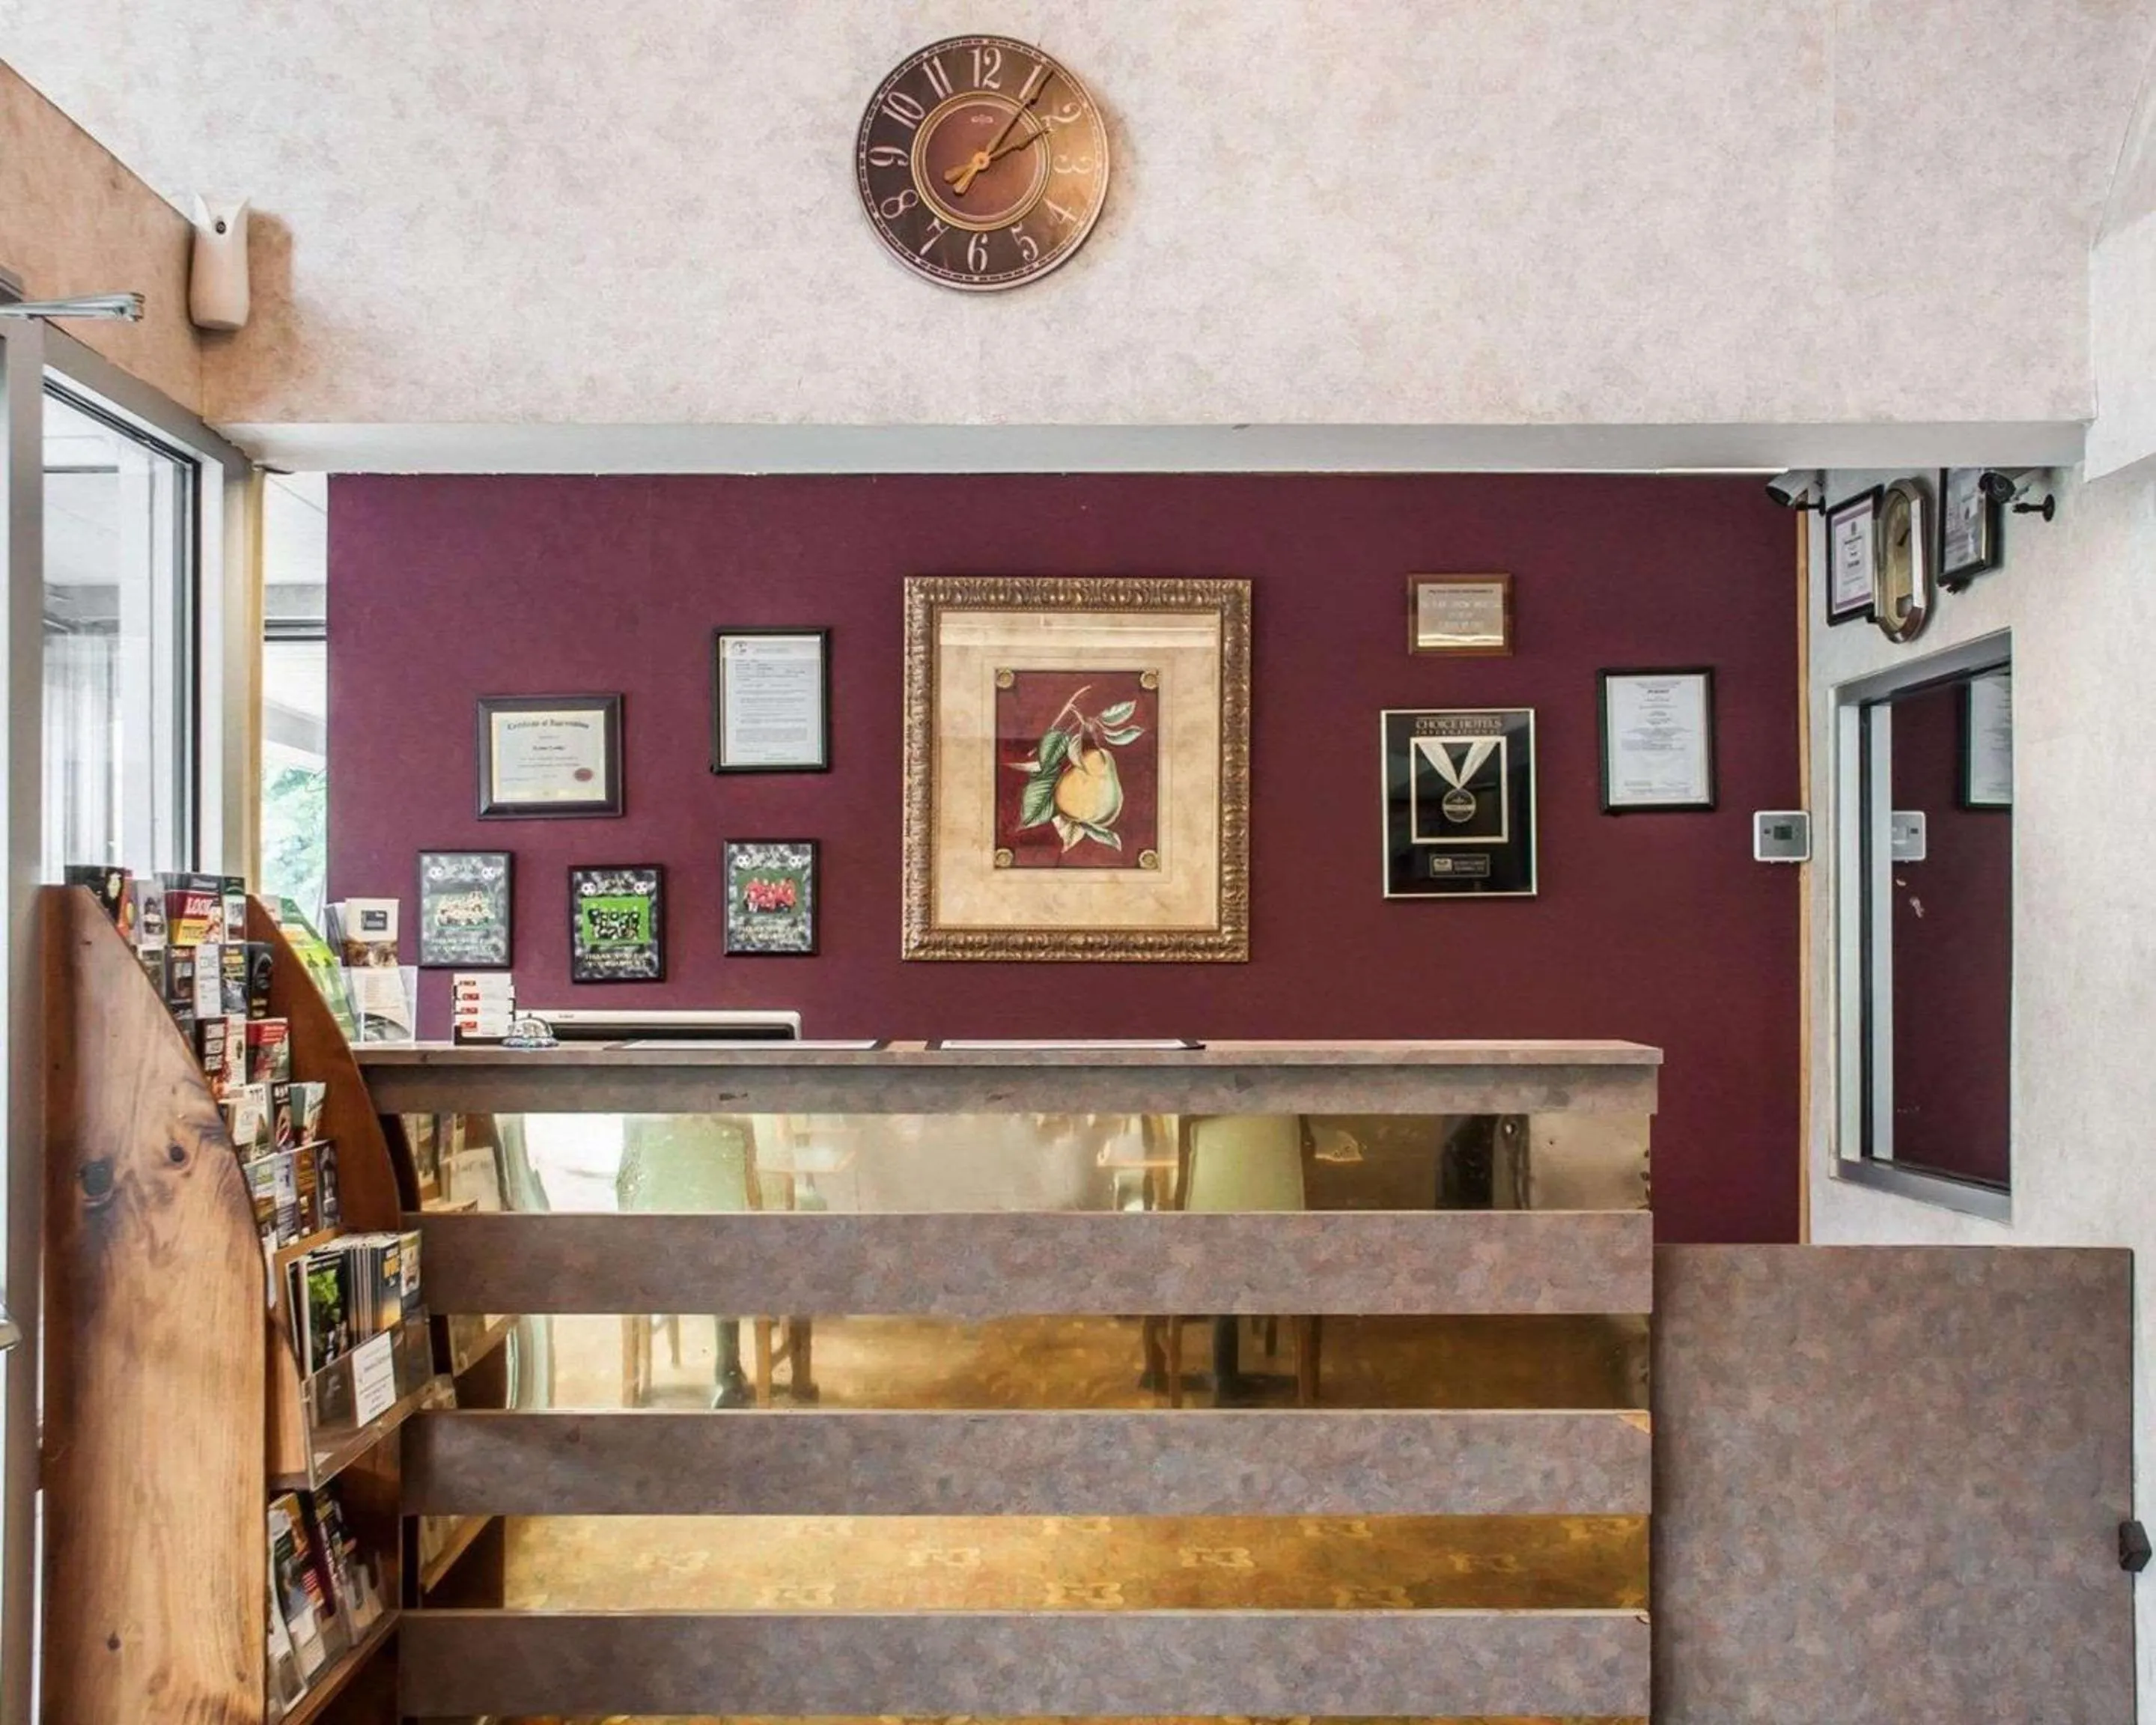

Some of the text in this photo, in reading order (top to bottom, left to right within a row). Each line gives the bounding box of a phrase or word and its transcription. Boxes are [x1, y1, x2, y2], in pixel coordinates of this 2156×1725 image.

[921, 55, 954, 100] 11
[968, 46, 1002, 90] 12
[1017, 64, 1043, 100] 1
[880, 91, 926, 130] 10
[1040, 102, 1082, 136] 2
[868, 146, 910, 168] 9
[1053, 153, 1094, 174] 3
[879, 189, 919, 220] 8
[1042, 196, 1078, 225] 4
[919, 217, 950, 256] 7
[966, 232, 989, 273] 6
[1011, 221, 1040, 262] 5
